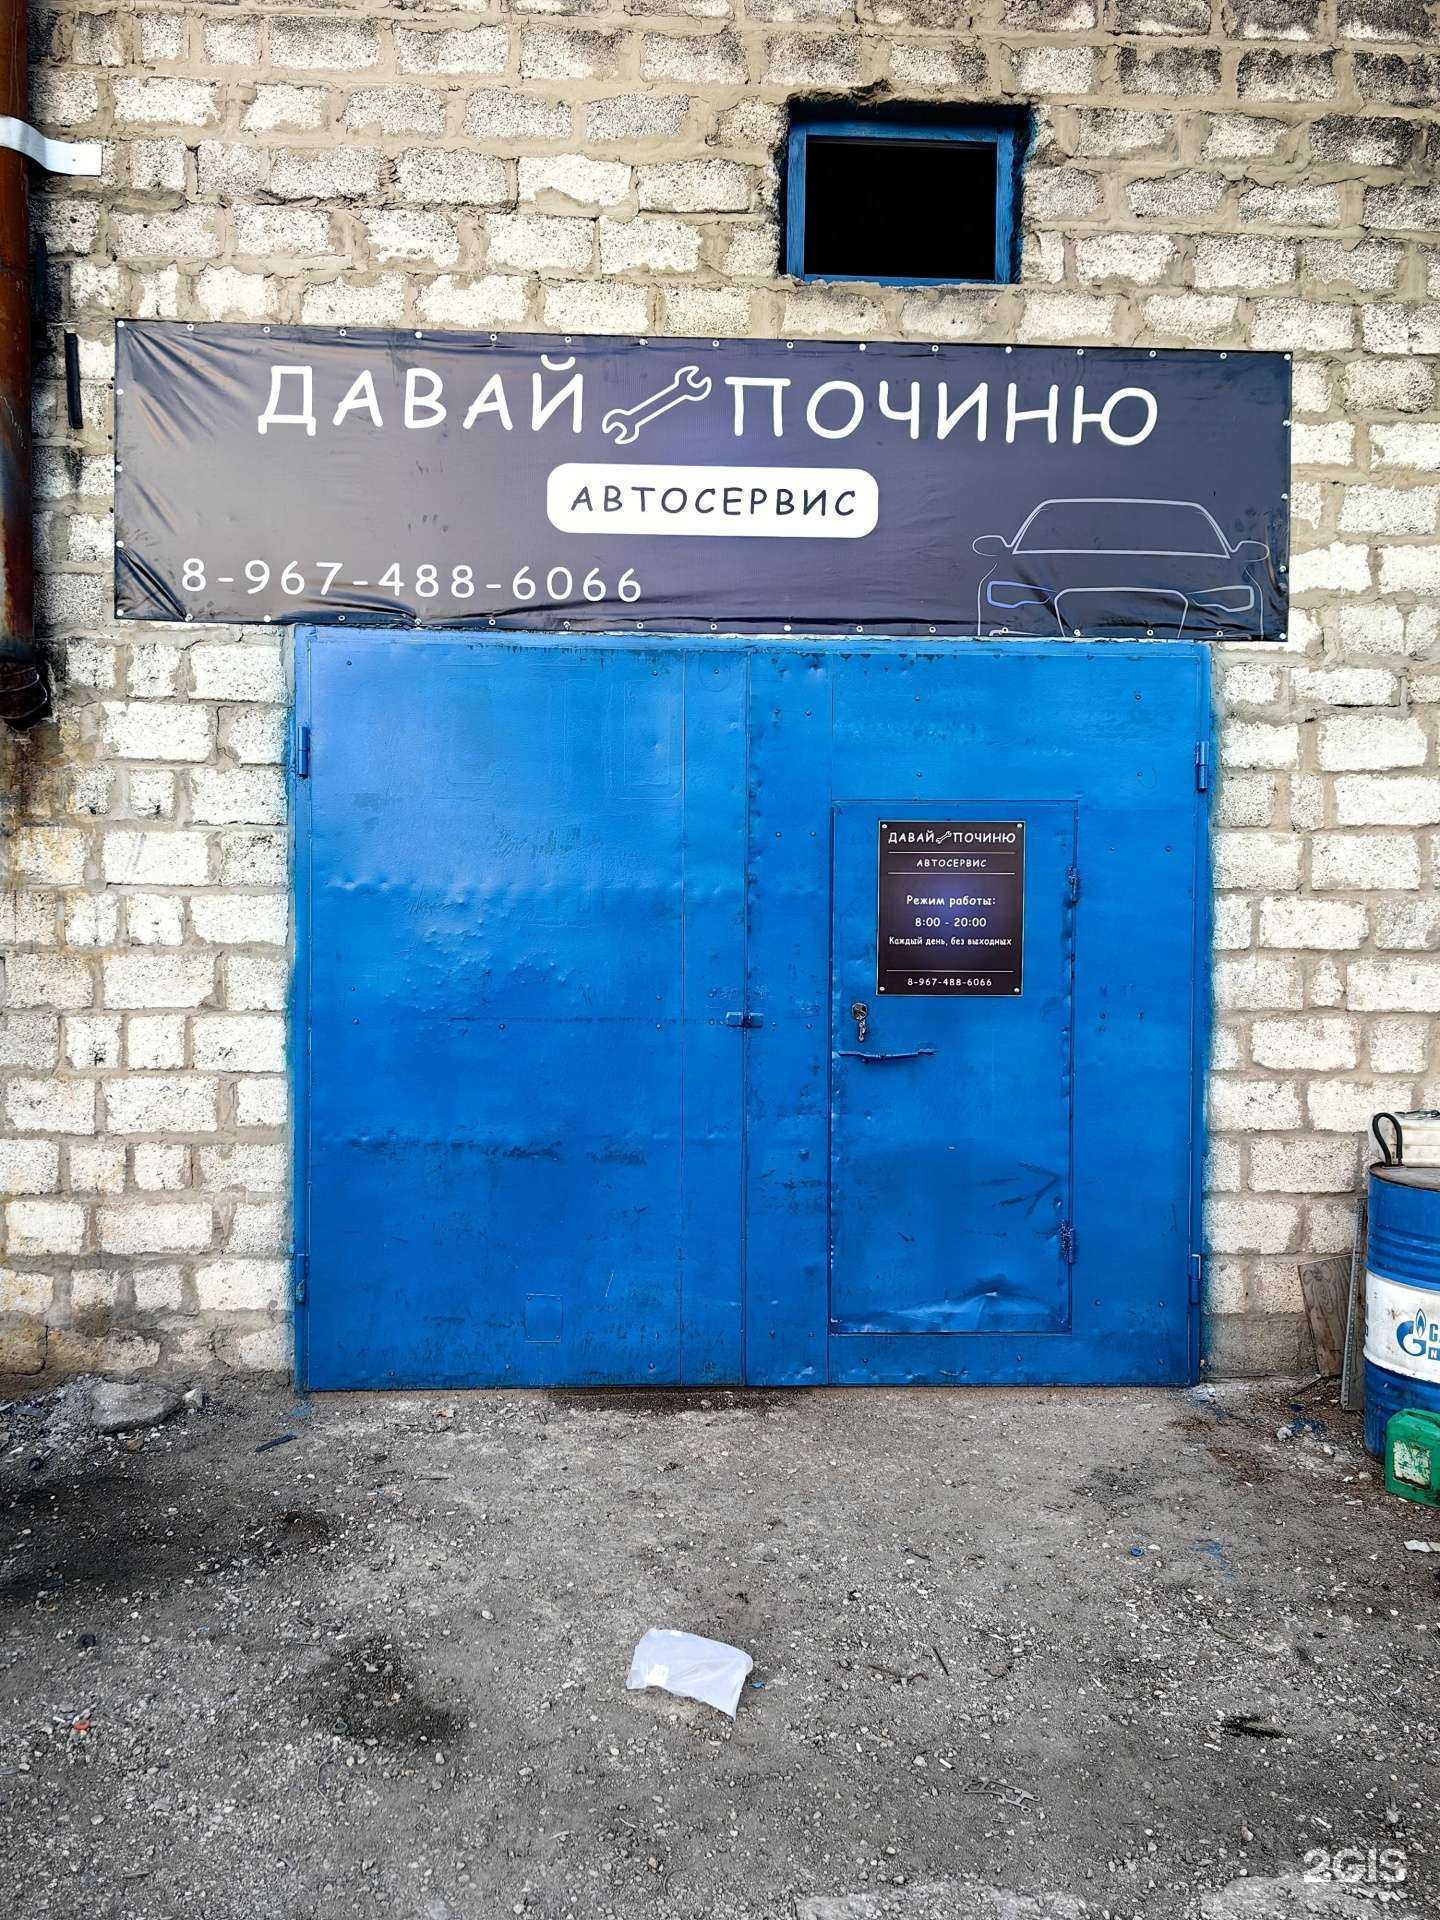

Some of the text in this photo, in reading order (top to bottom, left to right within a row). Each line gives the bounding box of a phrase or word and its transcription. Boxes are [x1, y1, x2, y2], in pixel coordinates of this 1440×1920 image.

[257, 354, 1159, 447] ДАВАЙ ПОЧИНЮ
[571, 484, 857, 520] АВТОСЕРВИС
[180, 557, 643, 604] 8-967-488-6066
[888, 830, 1016, 844] ДАВАЙ ПОЧИНЮ
[916, 858, 987, 868] АВТОСЕРВИС
[906, 895, 996, 908] Режим работы:
[915, 917, 941, 928] 8:00
[954, 917, 987, 928] 20:00
[889, 936, 1012, 947] Каждый день, без выходных
[907, 978, 992, 987] 8-967-488-6066
